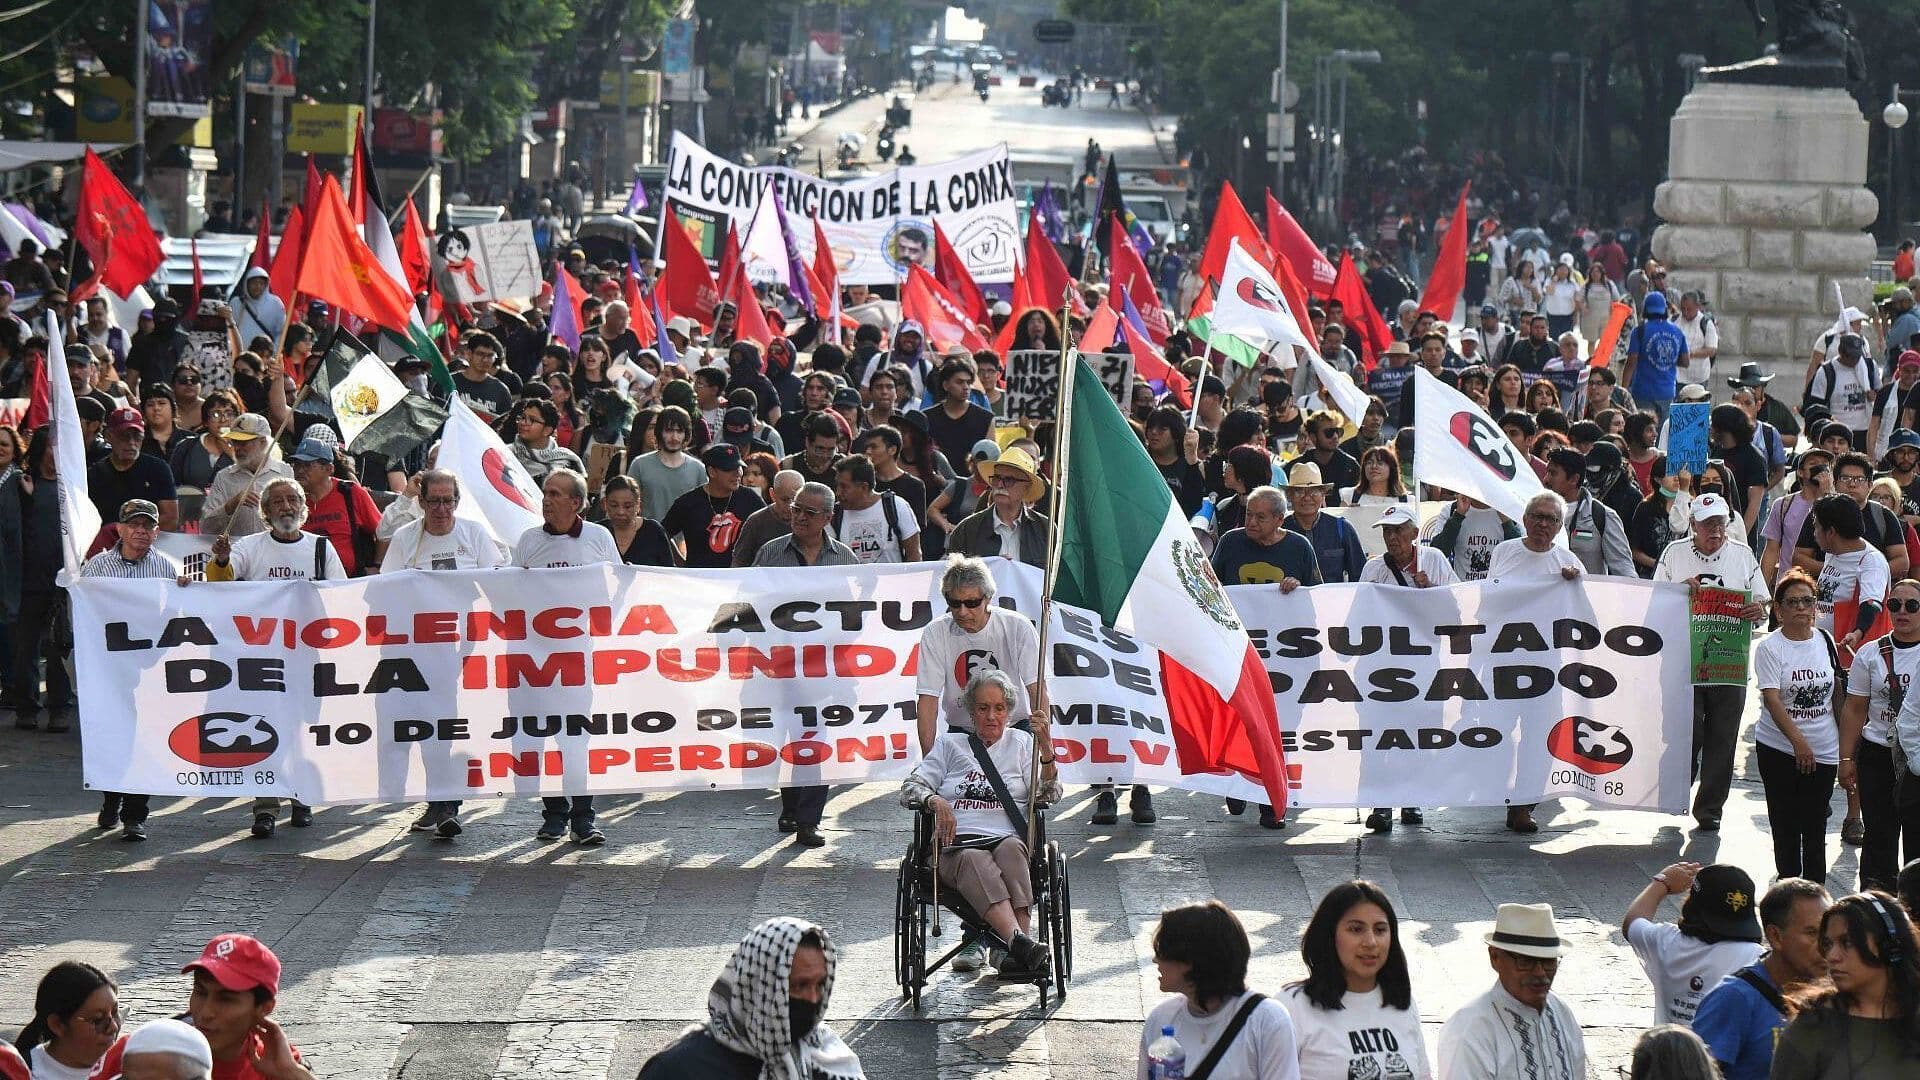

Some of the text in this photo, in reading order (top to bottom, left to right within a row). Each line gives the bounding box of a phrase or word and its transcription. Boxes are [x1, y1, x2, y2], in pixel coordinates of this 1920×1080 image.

[668, 147, 1013, 222] LA CONVENCION DE LA CDMX
[676, 204, 715, 223] Congreso
[1014, 353, 1060, 375] NIE
[1008, 397, 1059, 420] HER
[851, 540, 880, 553] FILA
[1467, 535, 1488, 546] ALTO
[269, 567, 291, 577] ALTO
[105, 616, 218, 651] LA
[233, 604, 678, 650] VIOLENCIA
[1060, 607, 1140, 653] ES
[1246, 618, 1663, 660] ESULTADO
[165, 658, 286, 693] DE
[313, 658, 430, 697] LA
[462, 643, 920, 689] IMPUNID
[1054, 643, 1157, 696] DE
[1791, 669, 1814, 681] ALTO
[1884, 673, 1910, 685] ATO
[309, 721, 372, 746] 10
[394, 718, 470, 743] DE
[490, 710, 677, 740] JUNIO
[697, 706, 774, 731] DE
[794, 699, 918, 728] 1971
[1050, 703, 1166, 735] MEN
[467, 749, 563, 787] ¡NI
[589, 731, 907, 776] PERDÓN!
[176, 768, 275, 786] COMITÉ 68
[1551, 770, 1624, 796] COMITÉ 68
[953, 800, 1003, 810] IMPUNIDA
[1348, 1027, 1399, 1055] ALTO
